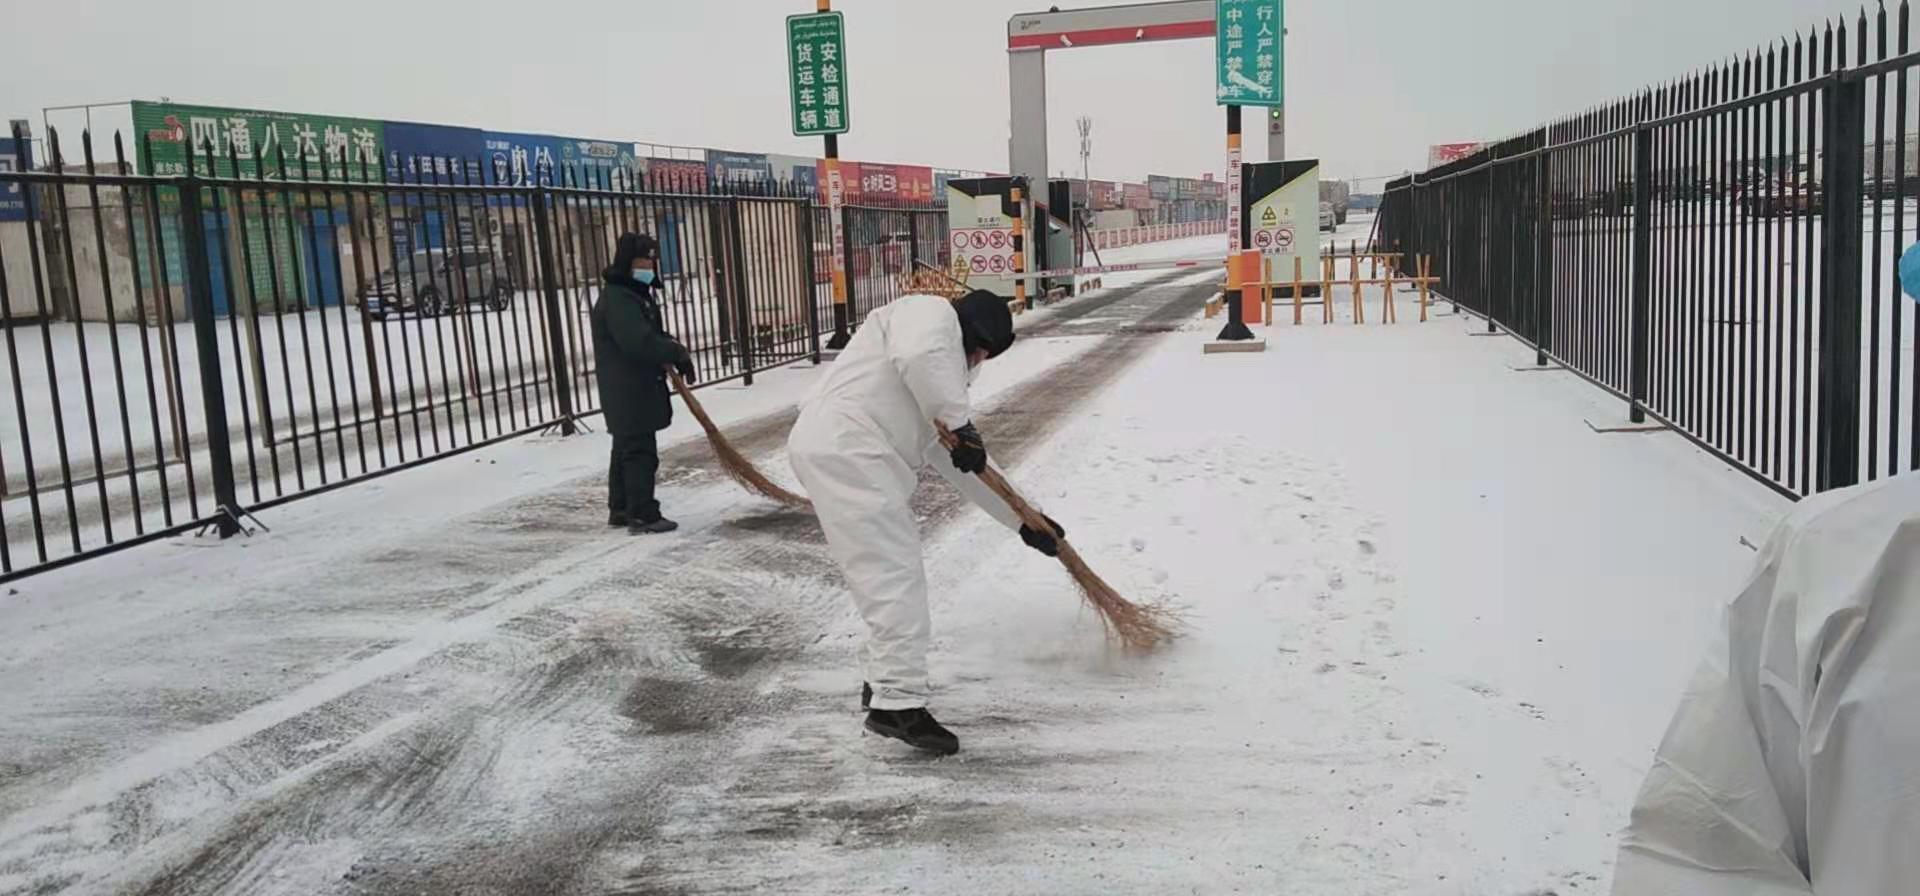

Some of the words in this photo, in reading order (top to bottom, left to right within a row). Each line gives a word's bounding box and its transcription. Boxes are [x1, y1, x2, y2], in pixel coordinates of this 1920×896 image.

[796, 43, 818, 129] 货运车辆
[820, 41, 841, 128] 安检通道
[1256, 5, 1274, 98] 行人严禁穿行
[190, 116, 380, 164] 四通八达物流
